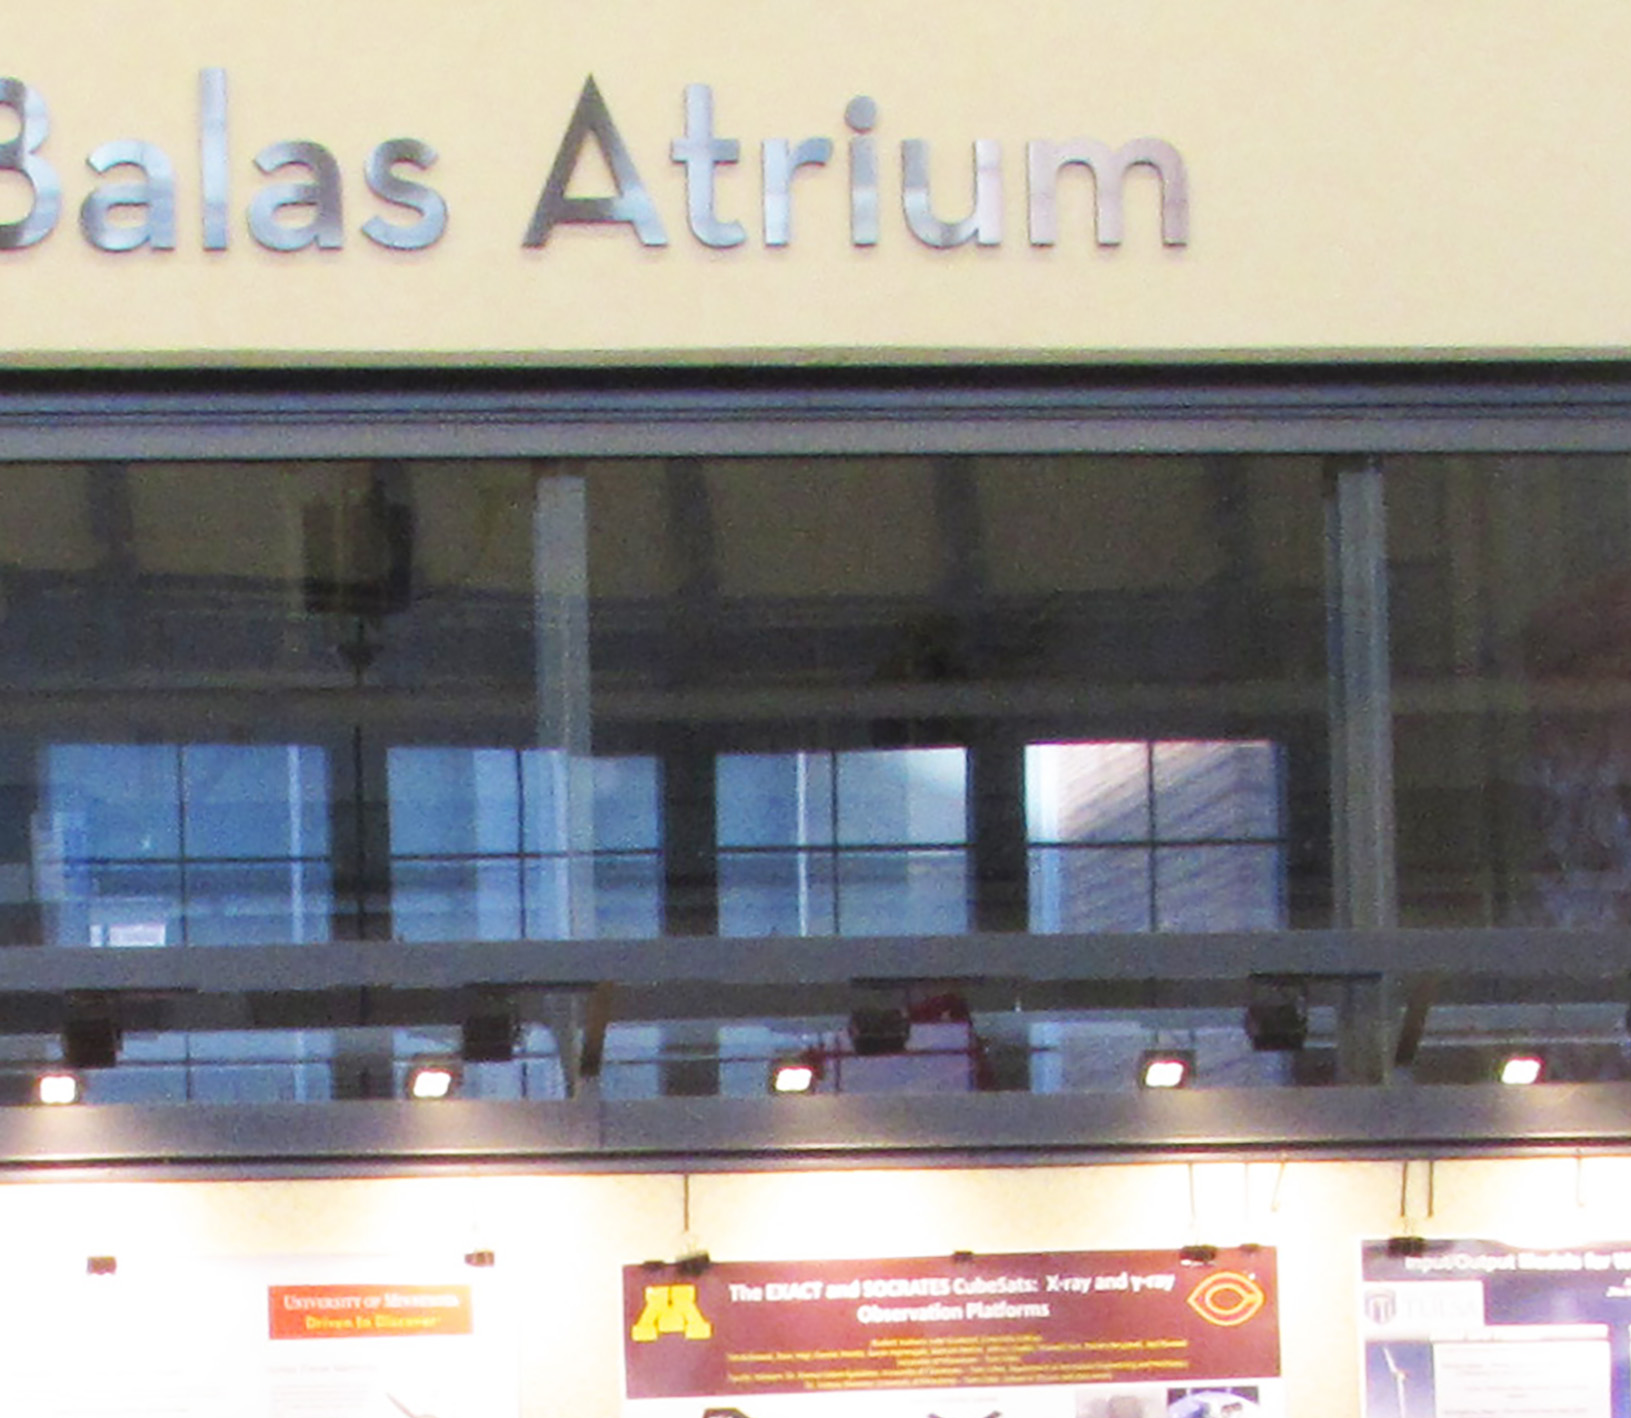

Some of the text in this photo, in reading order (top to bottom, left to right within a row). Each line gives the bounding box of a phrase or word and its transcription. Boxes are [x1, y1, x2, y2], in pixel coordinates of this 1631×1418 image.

[521, 74, 1190, 254] Atrium
[729, 1283, 762, 1301] The
[765, 1282, 824, 1301] EXACT
[826, 1281, 860, 1299] and
[862, 1278, 950, 1298] SOCRATES
[953, 1276, 1038, 1296] CubeSats:
[1046, 1275, 1091, 1294] X-ray
[1094, 1273, 1128, 1292] and
[305, 1315, 353, 1330] Driven
[356, 1315, 372, 1329] to
[857, 1301, 1050, 1323] Observation Platforms
